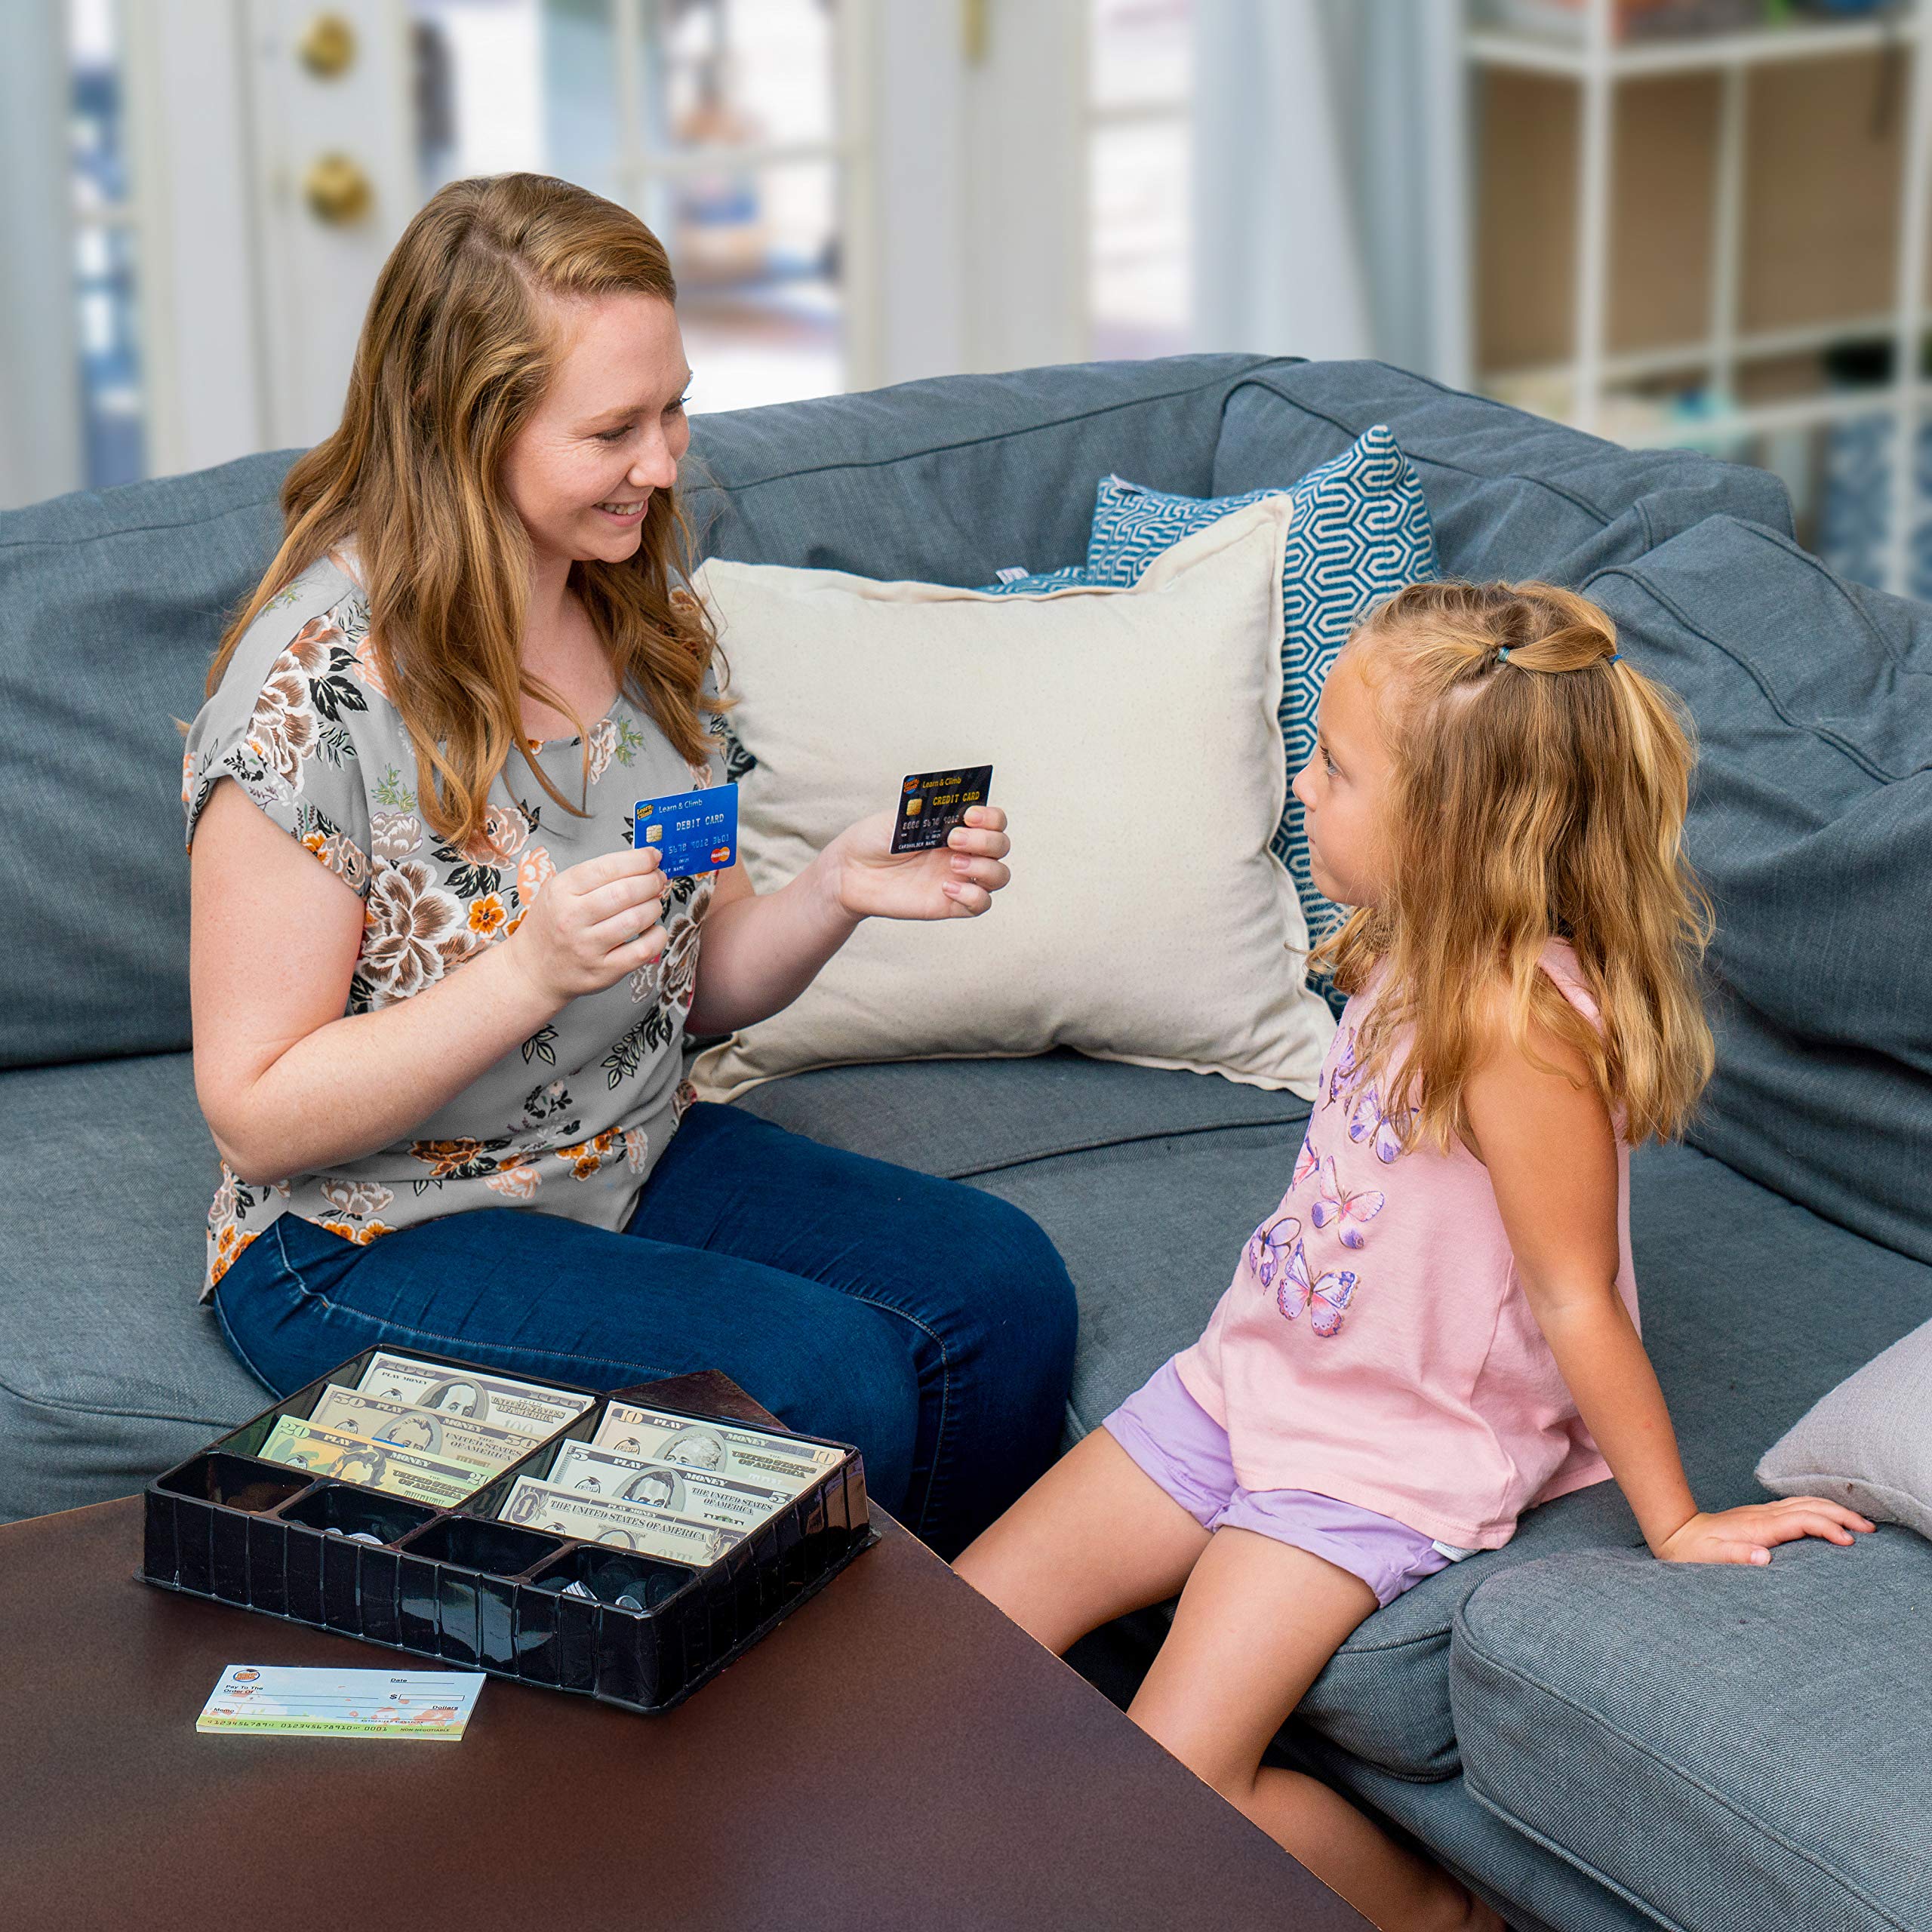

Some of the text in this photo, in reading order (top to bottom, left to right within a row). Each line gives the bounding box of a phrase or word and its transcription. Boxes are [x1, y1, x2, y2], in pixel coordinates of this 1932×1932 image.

[922, 776, 961, 789] Learn & Climb
[659, 799, 703, 814] Learn & Climb
[933, 791, 980, 806] CREDIT CARD
[637, 804, 654, 815] Learn
[638, 810, 653, 820] Climb
[676, 814, 724, 831] DEBIT CARD
[381, 1371, 428, 1386] PLAY MONEY
[334, 1393, 538, 1450] 50 PLAY MONEY 50
[279, 1423, 311, 1438] 20
[323, 1434, 353, 1446] PLAY
[389, 1451, 432, 1468] MONEY
[445, 1432, 524, 1457] UNITED STATES
[619, 1409, 836, 1465] 10 PLAY MONEY 10
[450, 1441, 465, 1450] OF
[464, 1444, 512, 1462] AMERICA
[571, 1447, 788, 1505] 5 PLAY MONEY 5
[516, 1498, 533, 1518] 1
[692, 1487, 774, 1512] THE UNITED STATES
[715, 1500, 754, 1515] AMERICA
[607, 1503, 658, 1518] PLAY MONEY
[550, 1500, 706, 1542] THE UNITED STATES OF AMERICA
